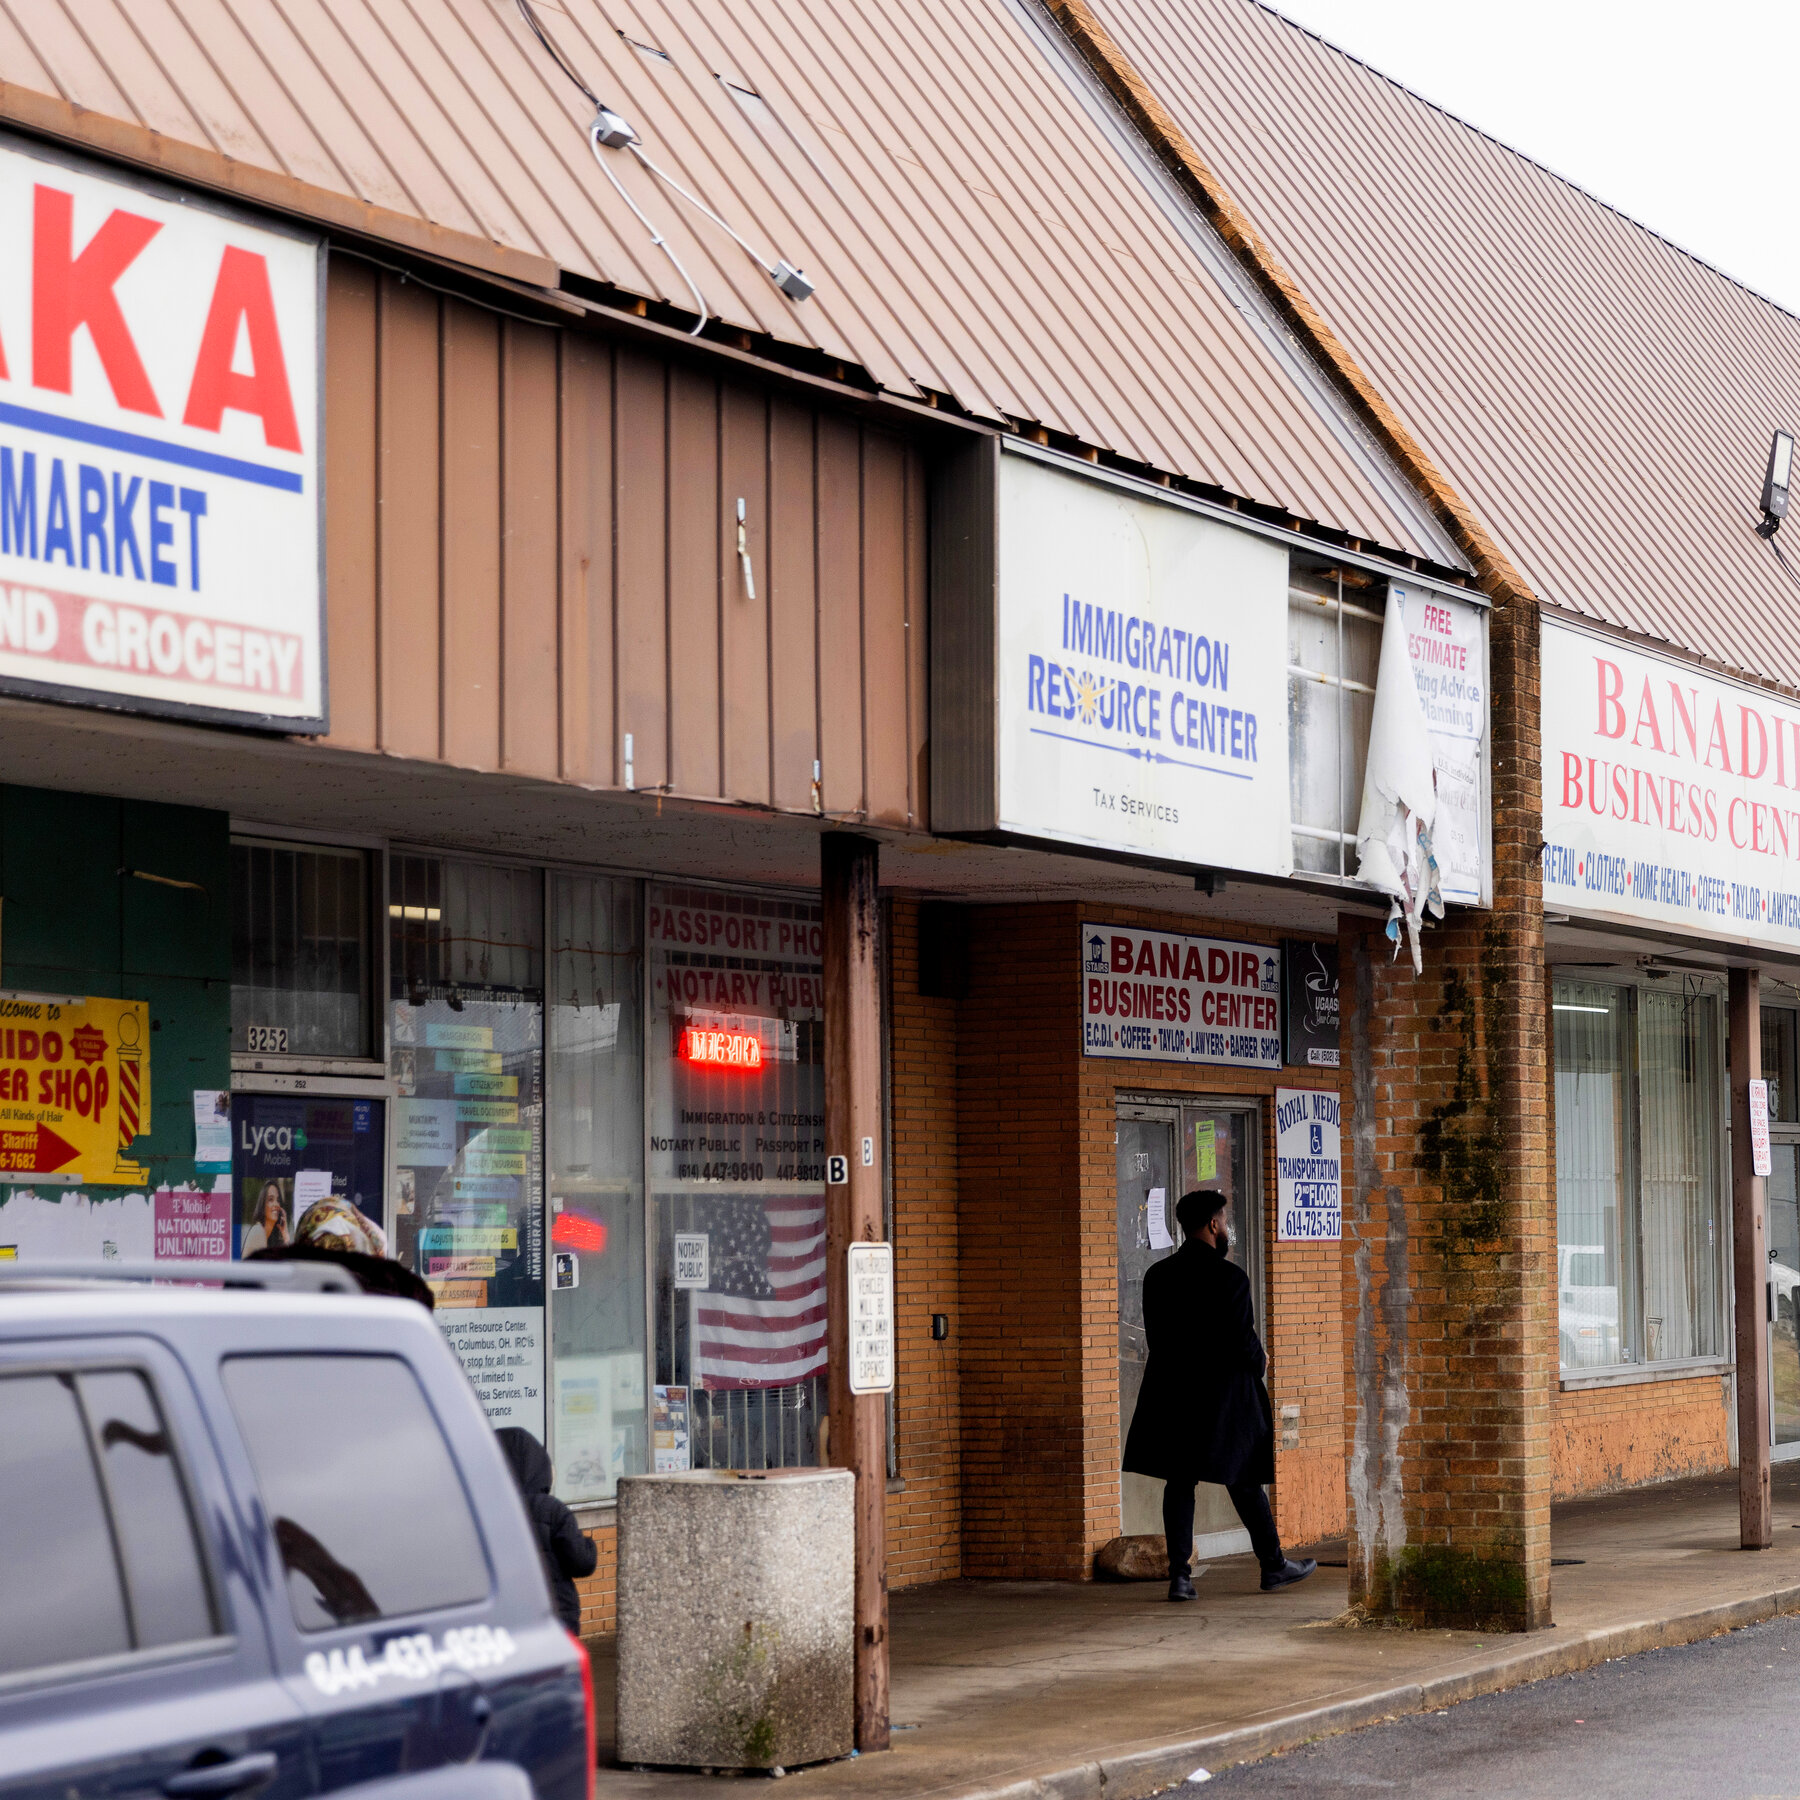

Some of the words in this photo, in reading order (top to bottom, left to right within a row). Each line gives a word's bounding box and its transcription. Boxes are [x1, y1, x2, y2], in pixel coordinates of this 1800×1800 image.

[0, 182, 304, 456] KA
[0, 445, 208, 593] MARKET
[1424, 604, 1453, 636] FREE
[82, 602, 299, 695] GROCERY
[1063, 593, 1229, 692] IMMIGRATION
[1408, 633, 1467, 671] ESTIMATE
[1440, 674, 1480, 703] Advice
[1028, 653, 1161, 741] RESOURCE
[1170, 690, 1258, 763] CENTER
[1093, 788, 1116, 811] TAX
[1121, 794, 1179, 824] SERVICES
[1559, 750, 1718, 842] BUSINESS
[1544, 845, 1576, 887] RETAIL
[1585, 851, 1626, 896] CLOTHES
[1632, 861, 1658, 902] HOME
[1660, 867, 1692, 908] HEALTH
[1697, 874, 1726, 915] COFFEE
[1731, 882, 1761, 921] TAYLOR
[649, 906, 772, 951] PASSPORT
[1085, 961, 1109, 974] STAIRS
[1110, 935, 1260, 989] BANADIR
[667, 968, 761, 1005] NOTARY
[1261, 981, 1279, 993] STAIRS
[1088, 978, 1191, 1023] BUSINESS
[1201, 990, 1277, 1031] CENTER
[0, 1028, 63, 1063] IDO
[249, 1027, 287, 1052] 3252
[1120, 1025, 1152, 1051] COFFEE
[1158, 1028, 1185, 1053] TAYLOR
[1190, 1031, 1225, 1056] LAWYERS
[1230, 1034, 1258, 1059] BARBER
[1261, 1037, 1280, 1060] SHOP
[38, 1066, 109, 1124] SHOP
[14, 1109, 35, 1121] Kinds
[37, 1110, 46, 1121] of
[47, 1112, 64, 1122] Hair
[681, 1109, 757, 1127] IMMIGRATION
[758, 1110, 766, 1126] &
[1276, 1095, 1309, 1135] ROYAL
[2, 1132, 39, 1150] Shariff
[242, 1120, 292, 1156] Lyca
[650, 1136, 695, 1152] NOTARY
[699, 1136, 741, 1152] PUBLIC
[755, 1138, 810, 1153] PASSPORT
[264, 1152, 291, 1166] Mobile
[864, 1139, 871, 1164] B
[678, 1163, 699, 1180] (614)
[702, 1162, 764, 1181] 447-9810
[830, 1157, 845, 1182] B
[1278, 1157, 1339, 1181] TRANSPORTATION
[182, 1199, 211, 1214] Mobile
[1309, 1184, 1338, 1208] FLOOR
[157, 1218, 226, 1235] NATIONWIDE
[531, 1187, 542, 1281] IMMIGRATION
[157, 1238, 226, 1256] UNLIMITED
[677, 1242, 705, 1259] NOTARY
[678, 1261, 705, 1278] PUBLIC
[858, 1277, 885, 1295] VEHICLES
[859, 1298, 873, 1316] WILL
[877, 1297, 885, 1315] BE
[469, 1321, 503, 1334] Resource
[854, 1319, 873, 1337] TOWED
[875, 1318, 889, 1337] AWAY
[458, 1338, 497, 1351] Columbus,
[855, 1340, 863, 1358] AT
[467, 1355, 484, 1369] stop
[485, 1354, 495, 1367] for
[496, 1354, 506, 1366] all
[859, 1359, 885, 1379] EXPENSE
[481, 1371, 506, 1383] limited
[507, 1372, 514, 1383] to
[524, 1386, 538, 1398] Tax
